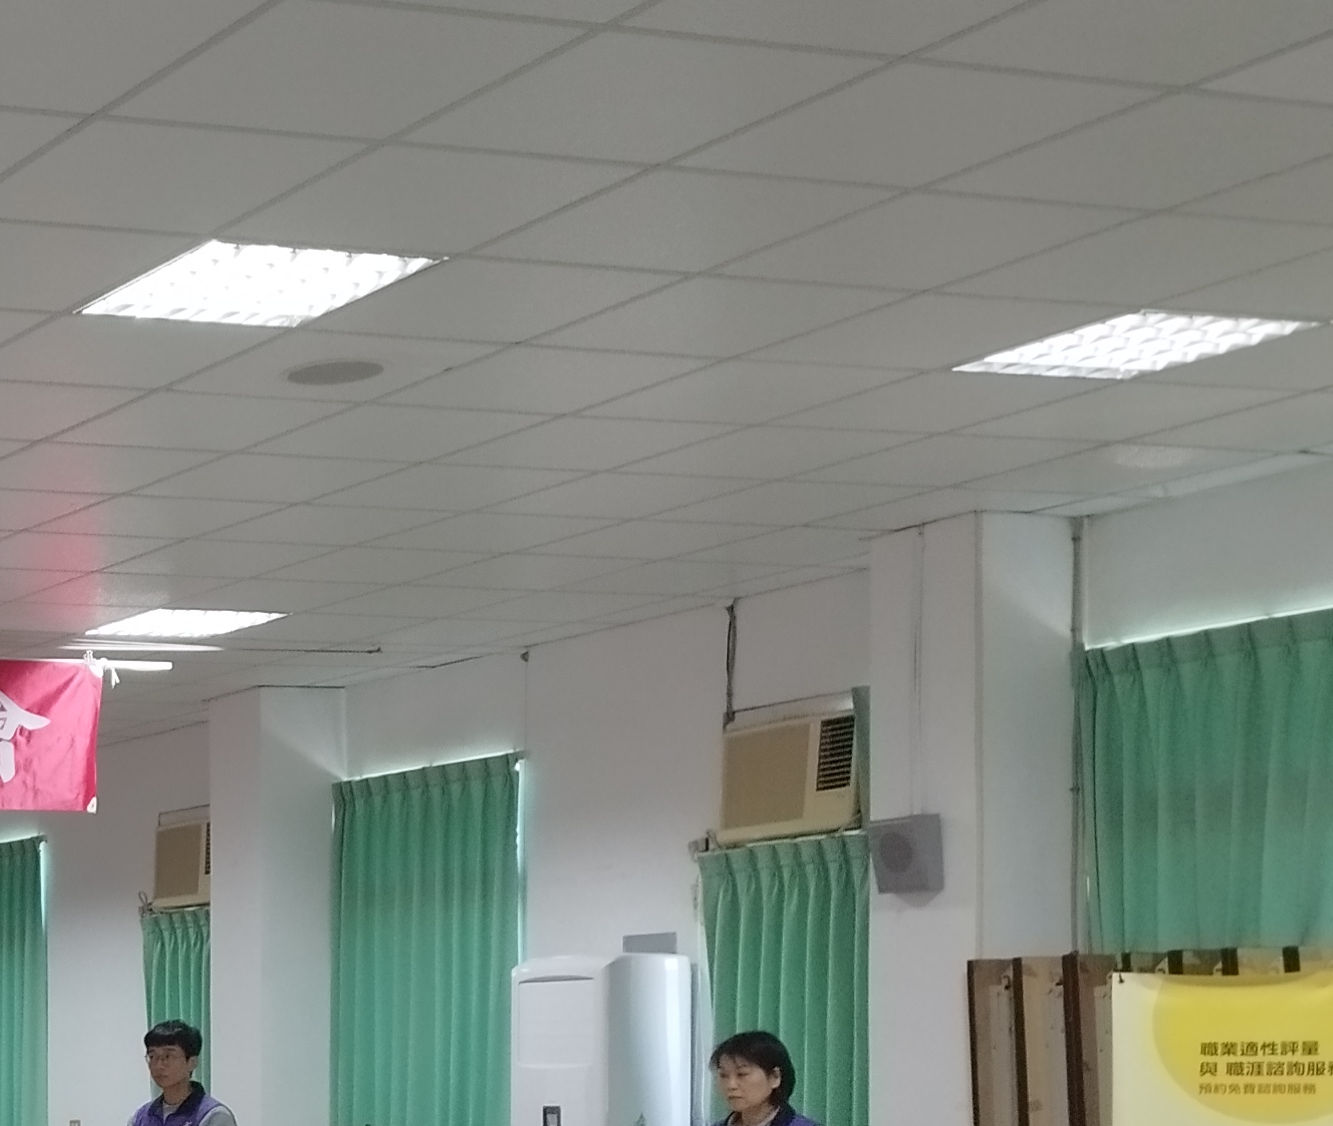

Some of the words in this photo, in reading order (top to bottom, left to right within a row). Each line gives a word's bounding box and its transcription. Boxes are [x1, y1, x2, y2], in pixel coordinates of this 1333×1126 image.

[1200, 1041, 1319, 1056] 職業適性評量
[1200, 1061, 1218, 1076] 與
